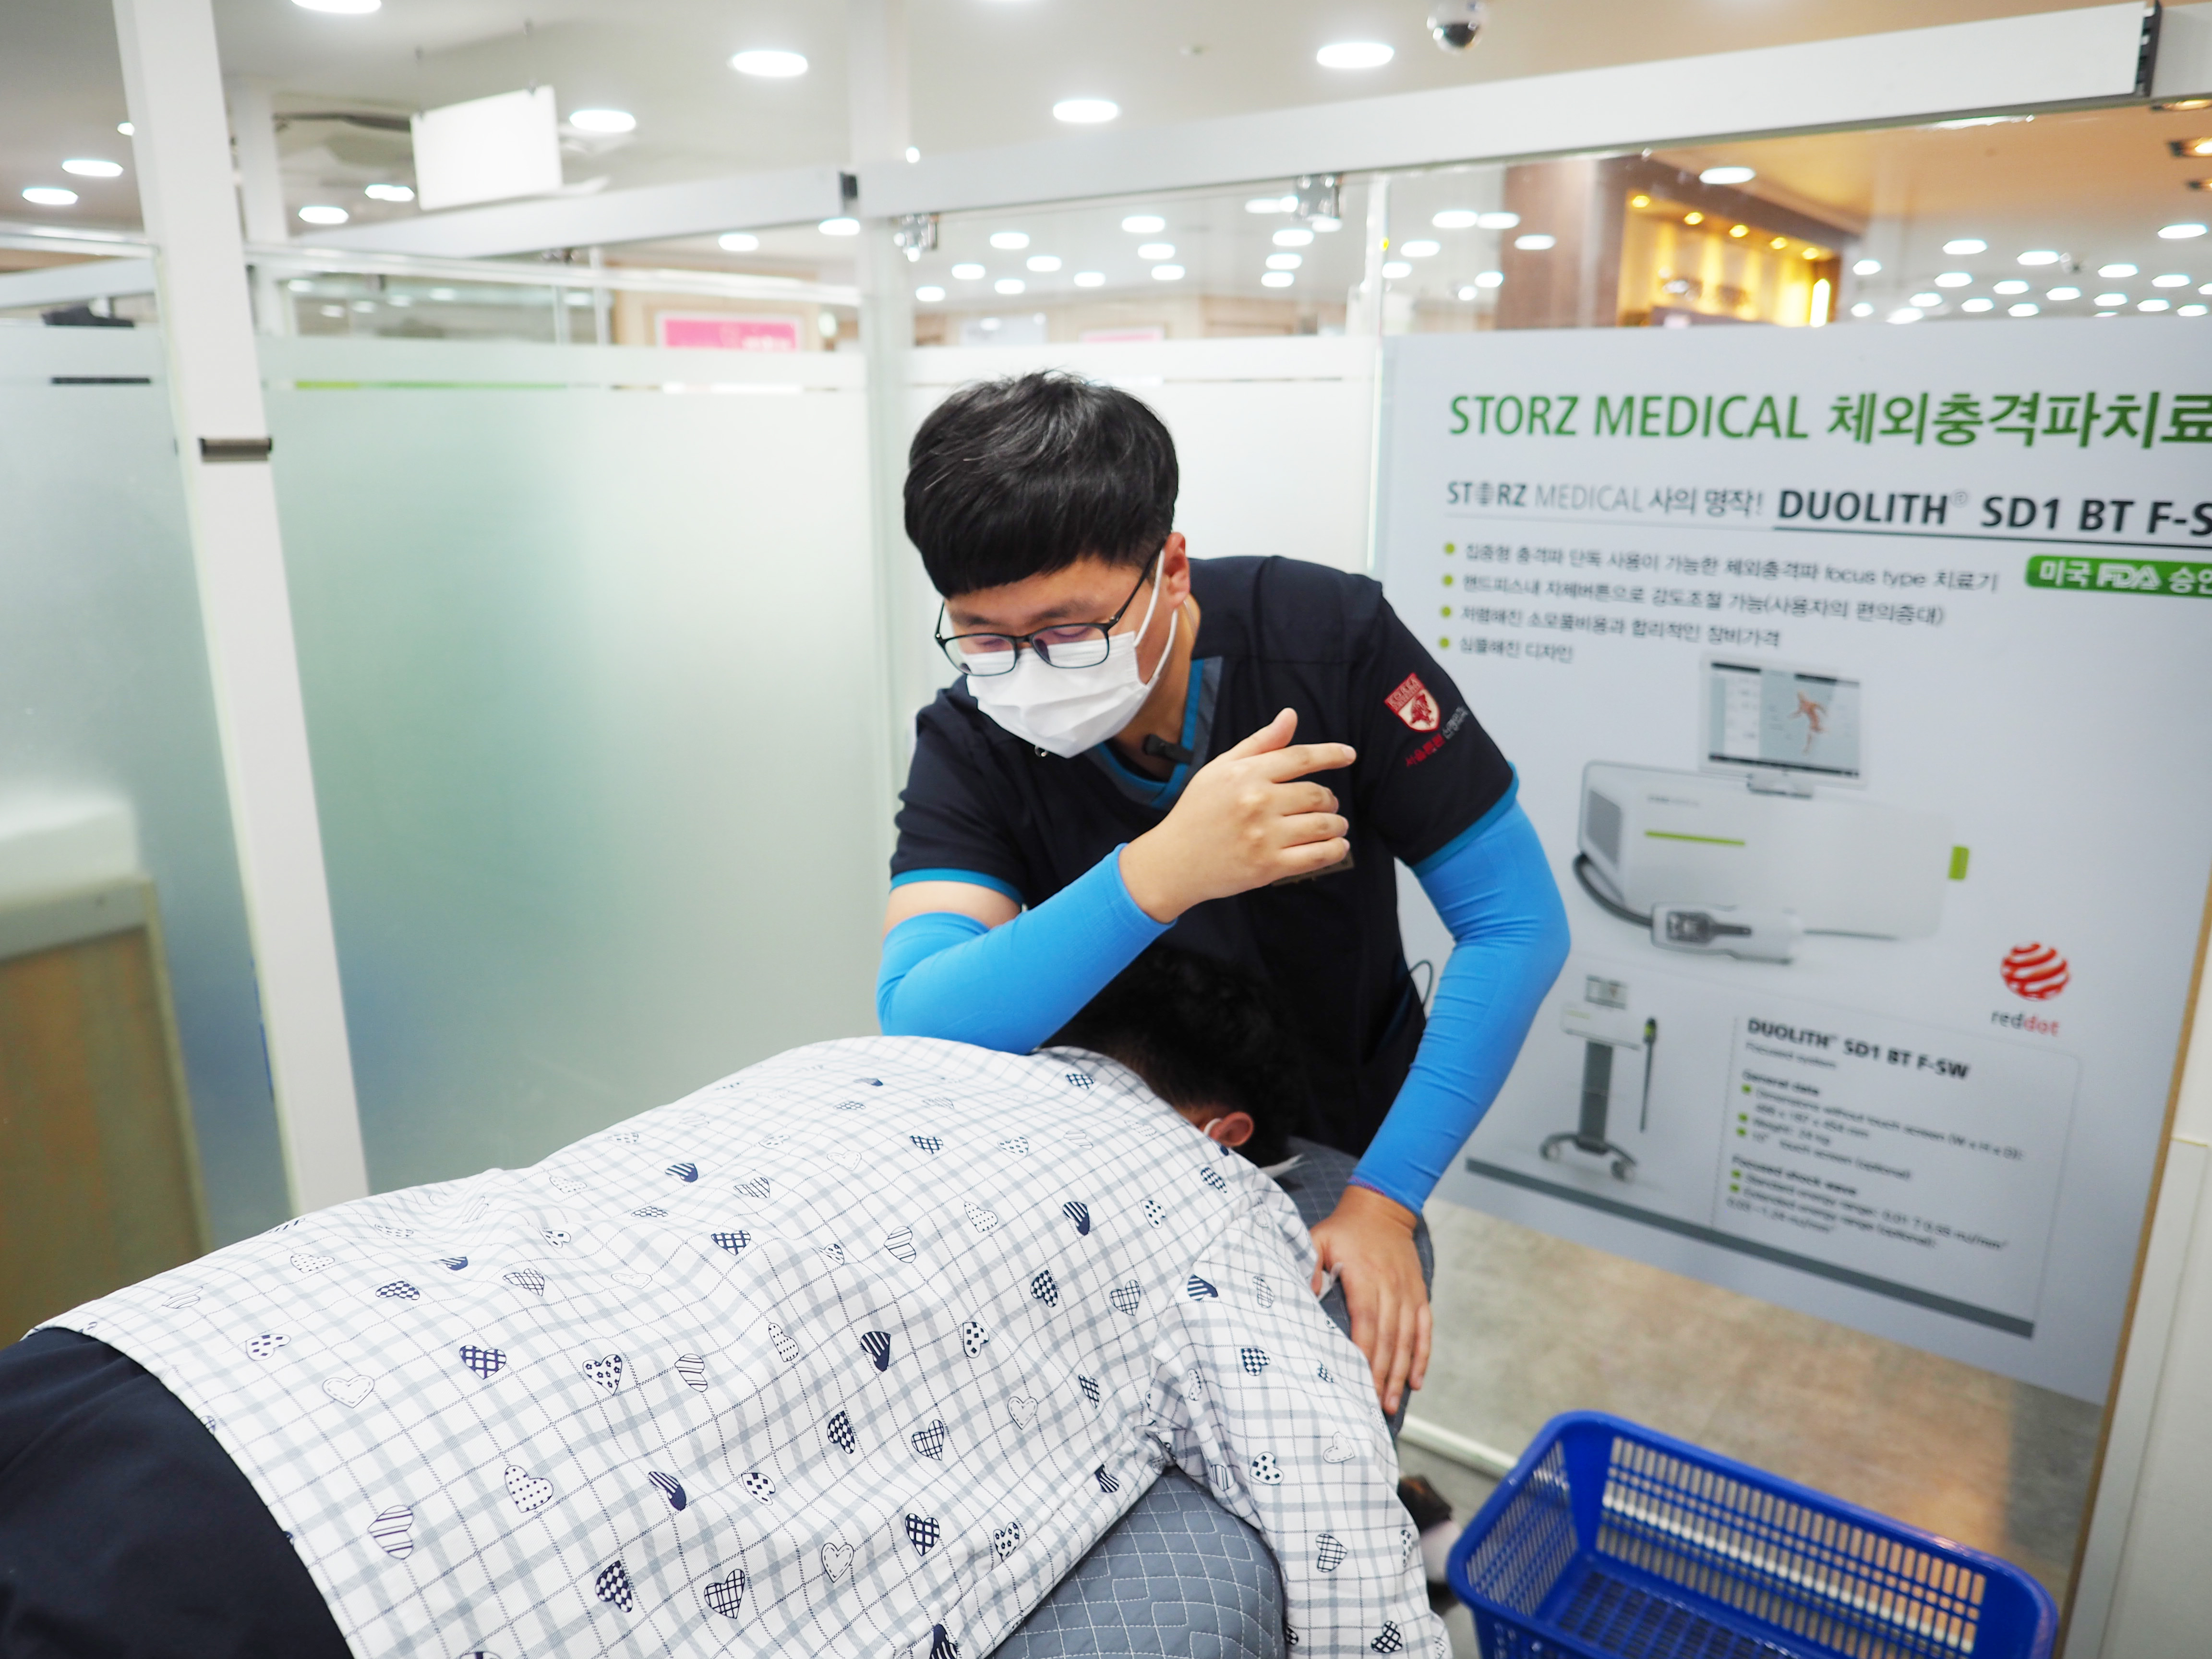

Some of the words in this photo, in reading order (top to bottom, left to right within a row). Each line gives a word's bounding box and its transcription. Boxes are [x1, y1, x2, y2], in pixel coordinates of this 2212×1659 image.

[1449, 395, 1579, 436] STORZ
[1594, 395, 1809, 439] MEDICAL
[1827, 390, 2212, 448] 체외충격파치료
[1536, 484, 1643, 512] MEDICAL
[1648, 488, 1696, 514] 사의
[1705, 488, 1764, 518] 명작!
[1980, 496, 2060, 529] SD1
[2079, 500, 2135, 533] BT
[1516, 546, 1563, 565] 충격파
[1569, 549, 1601, 567] 단독
[1608, 552, 1659, 572] 사용이
[1665, 553, 1719, 576] 가능한
[1726, 557, 1818, 580] 체외충격파
[1826, 564, 1876, 584] focus
[1882, 568, 1925, 588] type
[1932, 570, 1998, 594] 치료기
[2039, 559, 2091, 588] 미국
[2096, 563, 2162, 590] FDA
[1652, 587, 1722, 610] 강도조절
[1632, 618, 1700, 643] 합리적인
[1525, 641, 1574, 664] 디자인
[1991, 1010, 2059, 1037] reddot
[1844, 1038, 1880, 1059] SD1
[1887, 1048, 1911, 1066] BT
[1917, 1055, 1969, 1079] F-SW
